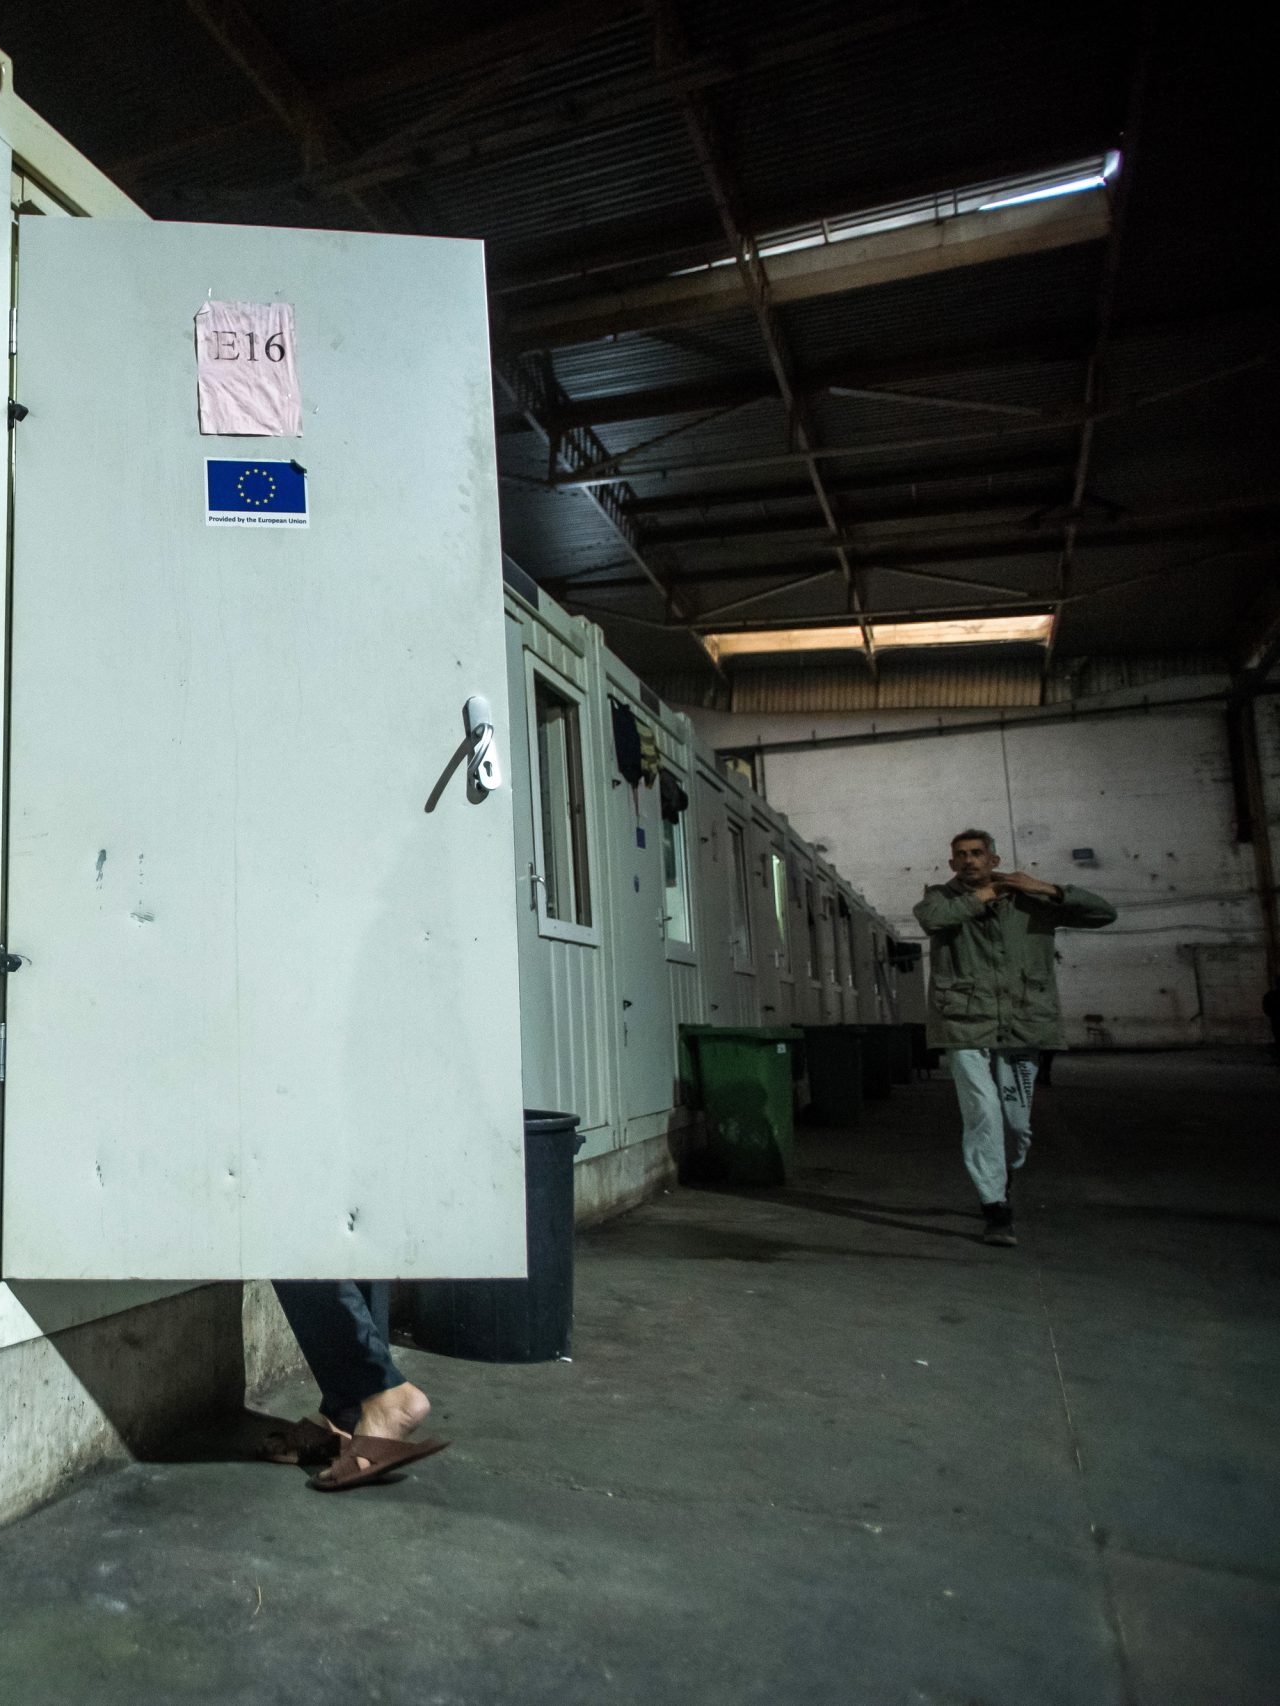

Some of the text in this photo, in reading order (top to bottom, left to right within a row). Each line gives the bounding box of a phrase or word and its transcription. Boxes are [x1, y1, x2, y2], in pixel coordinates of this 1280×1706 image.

[212, 330, 286, 363] E16
[237, 516, 245, 524] by
[246, 516, 257, 524] the
[257, 517, 287, 525] European
[1003, 1085, 1018, 1102] 24
